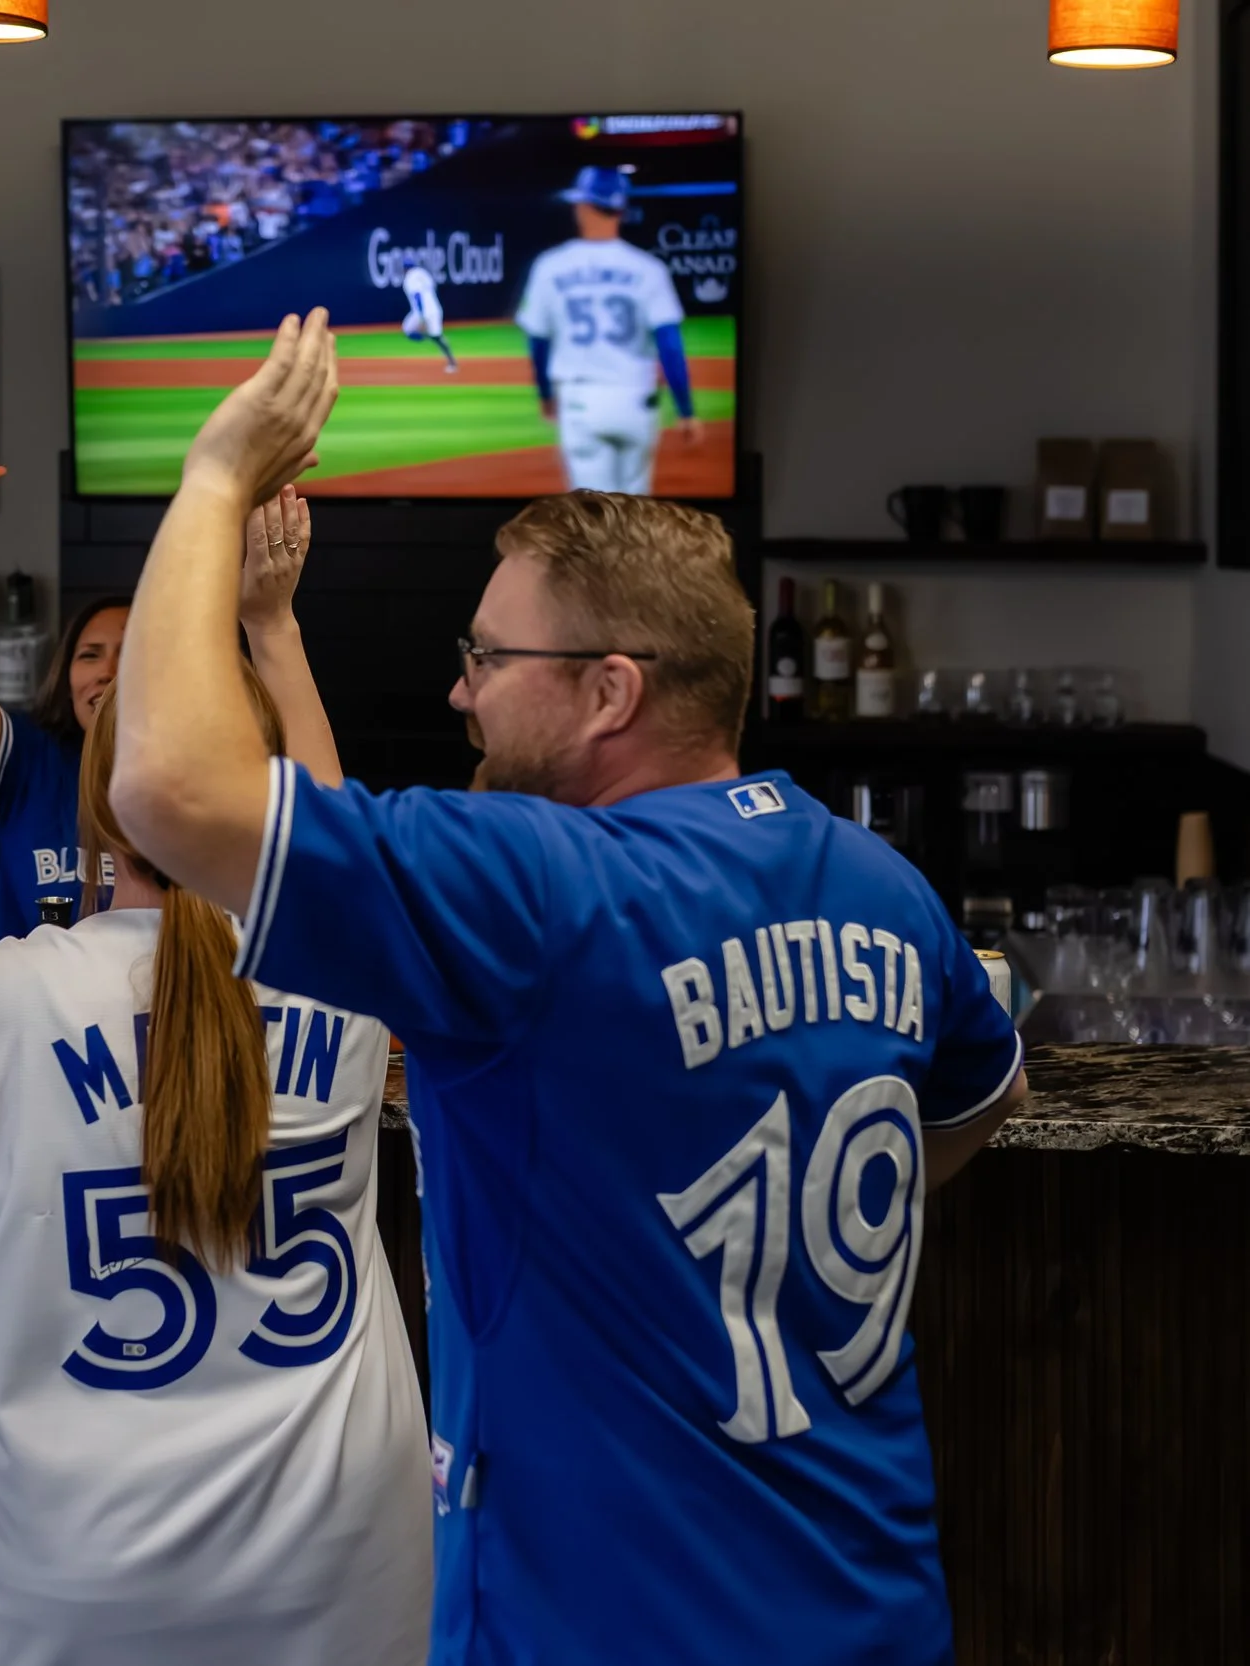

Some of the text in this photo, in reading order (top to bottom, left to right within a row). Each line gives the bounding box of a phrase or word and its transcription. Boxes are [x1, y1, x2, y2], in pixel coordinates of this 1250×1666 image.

[566, 295, 637, 346] 53
[51, 1006, 345, 1125] MIN
[661, 918, 924, 1069] BAUTISTA
[61, 1127, 357, 1390] 55
[655, 1075, 925, 1444] 19
